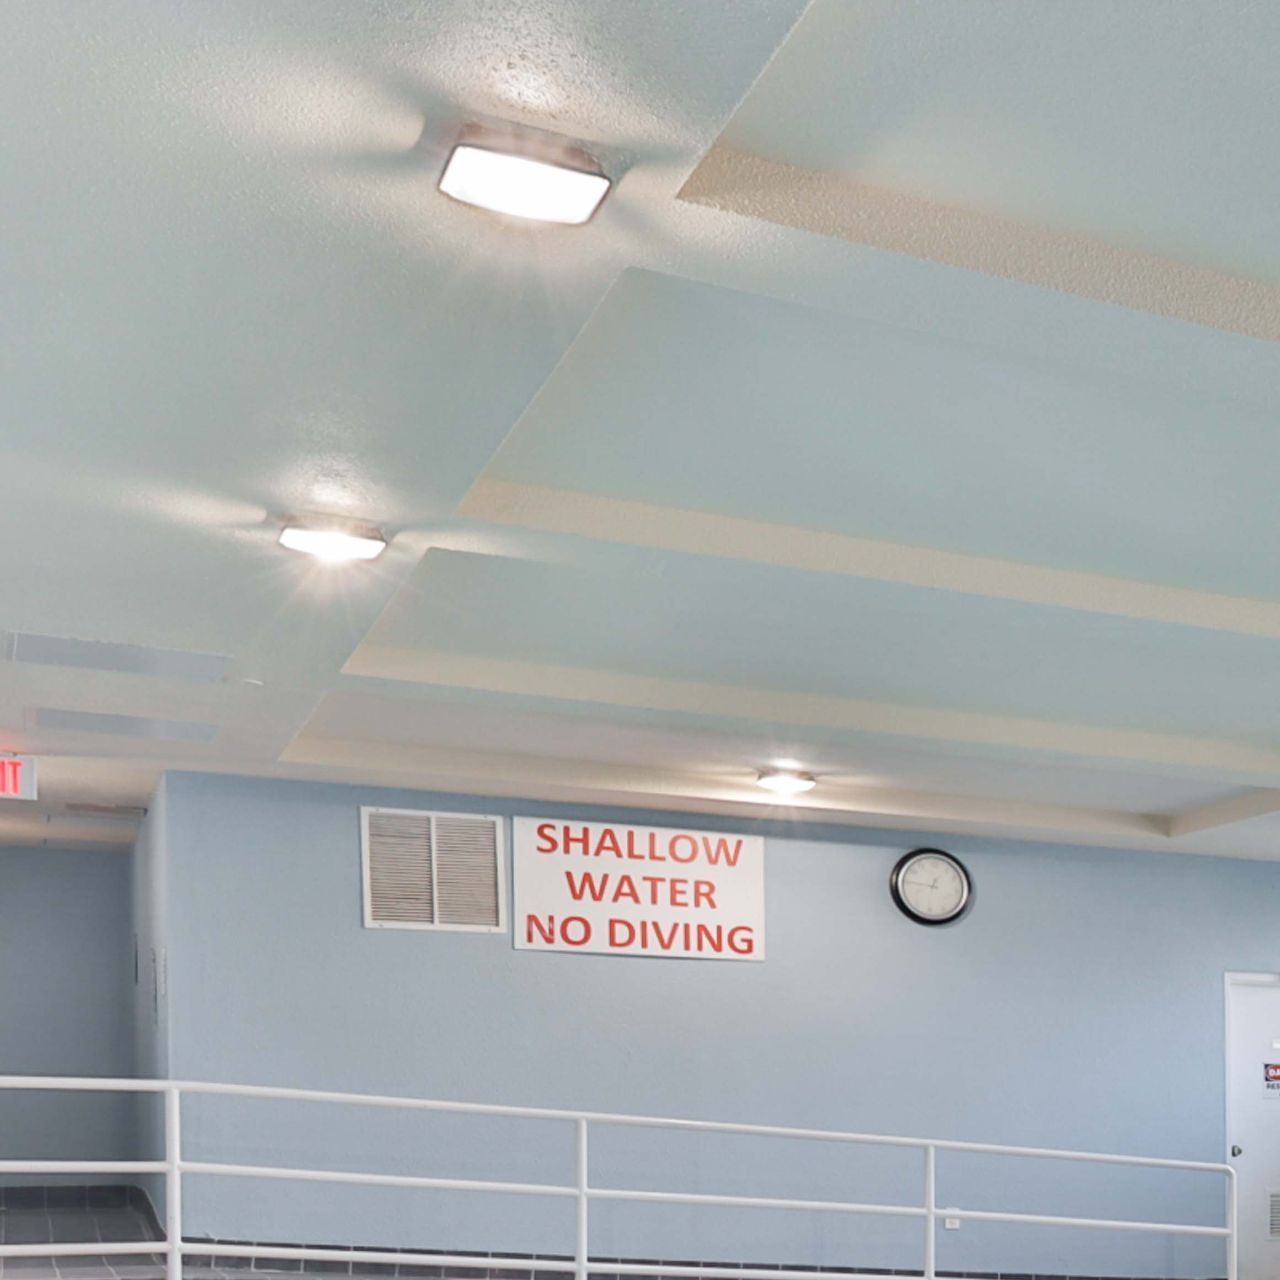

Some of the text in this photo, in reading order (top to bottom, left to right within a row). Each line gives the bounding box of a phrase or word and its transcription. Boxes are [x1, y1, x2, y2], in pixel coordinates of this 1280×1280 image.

[536, 823, 743, 867] SHALLOW
[565, 871, 717, 909] WATER
[526, 914, 754, 954] NO DIVING
